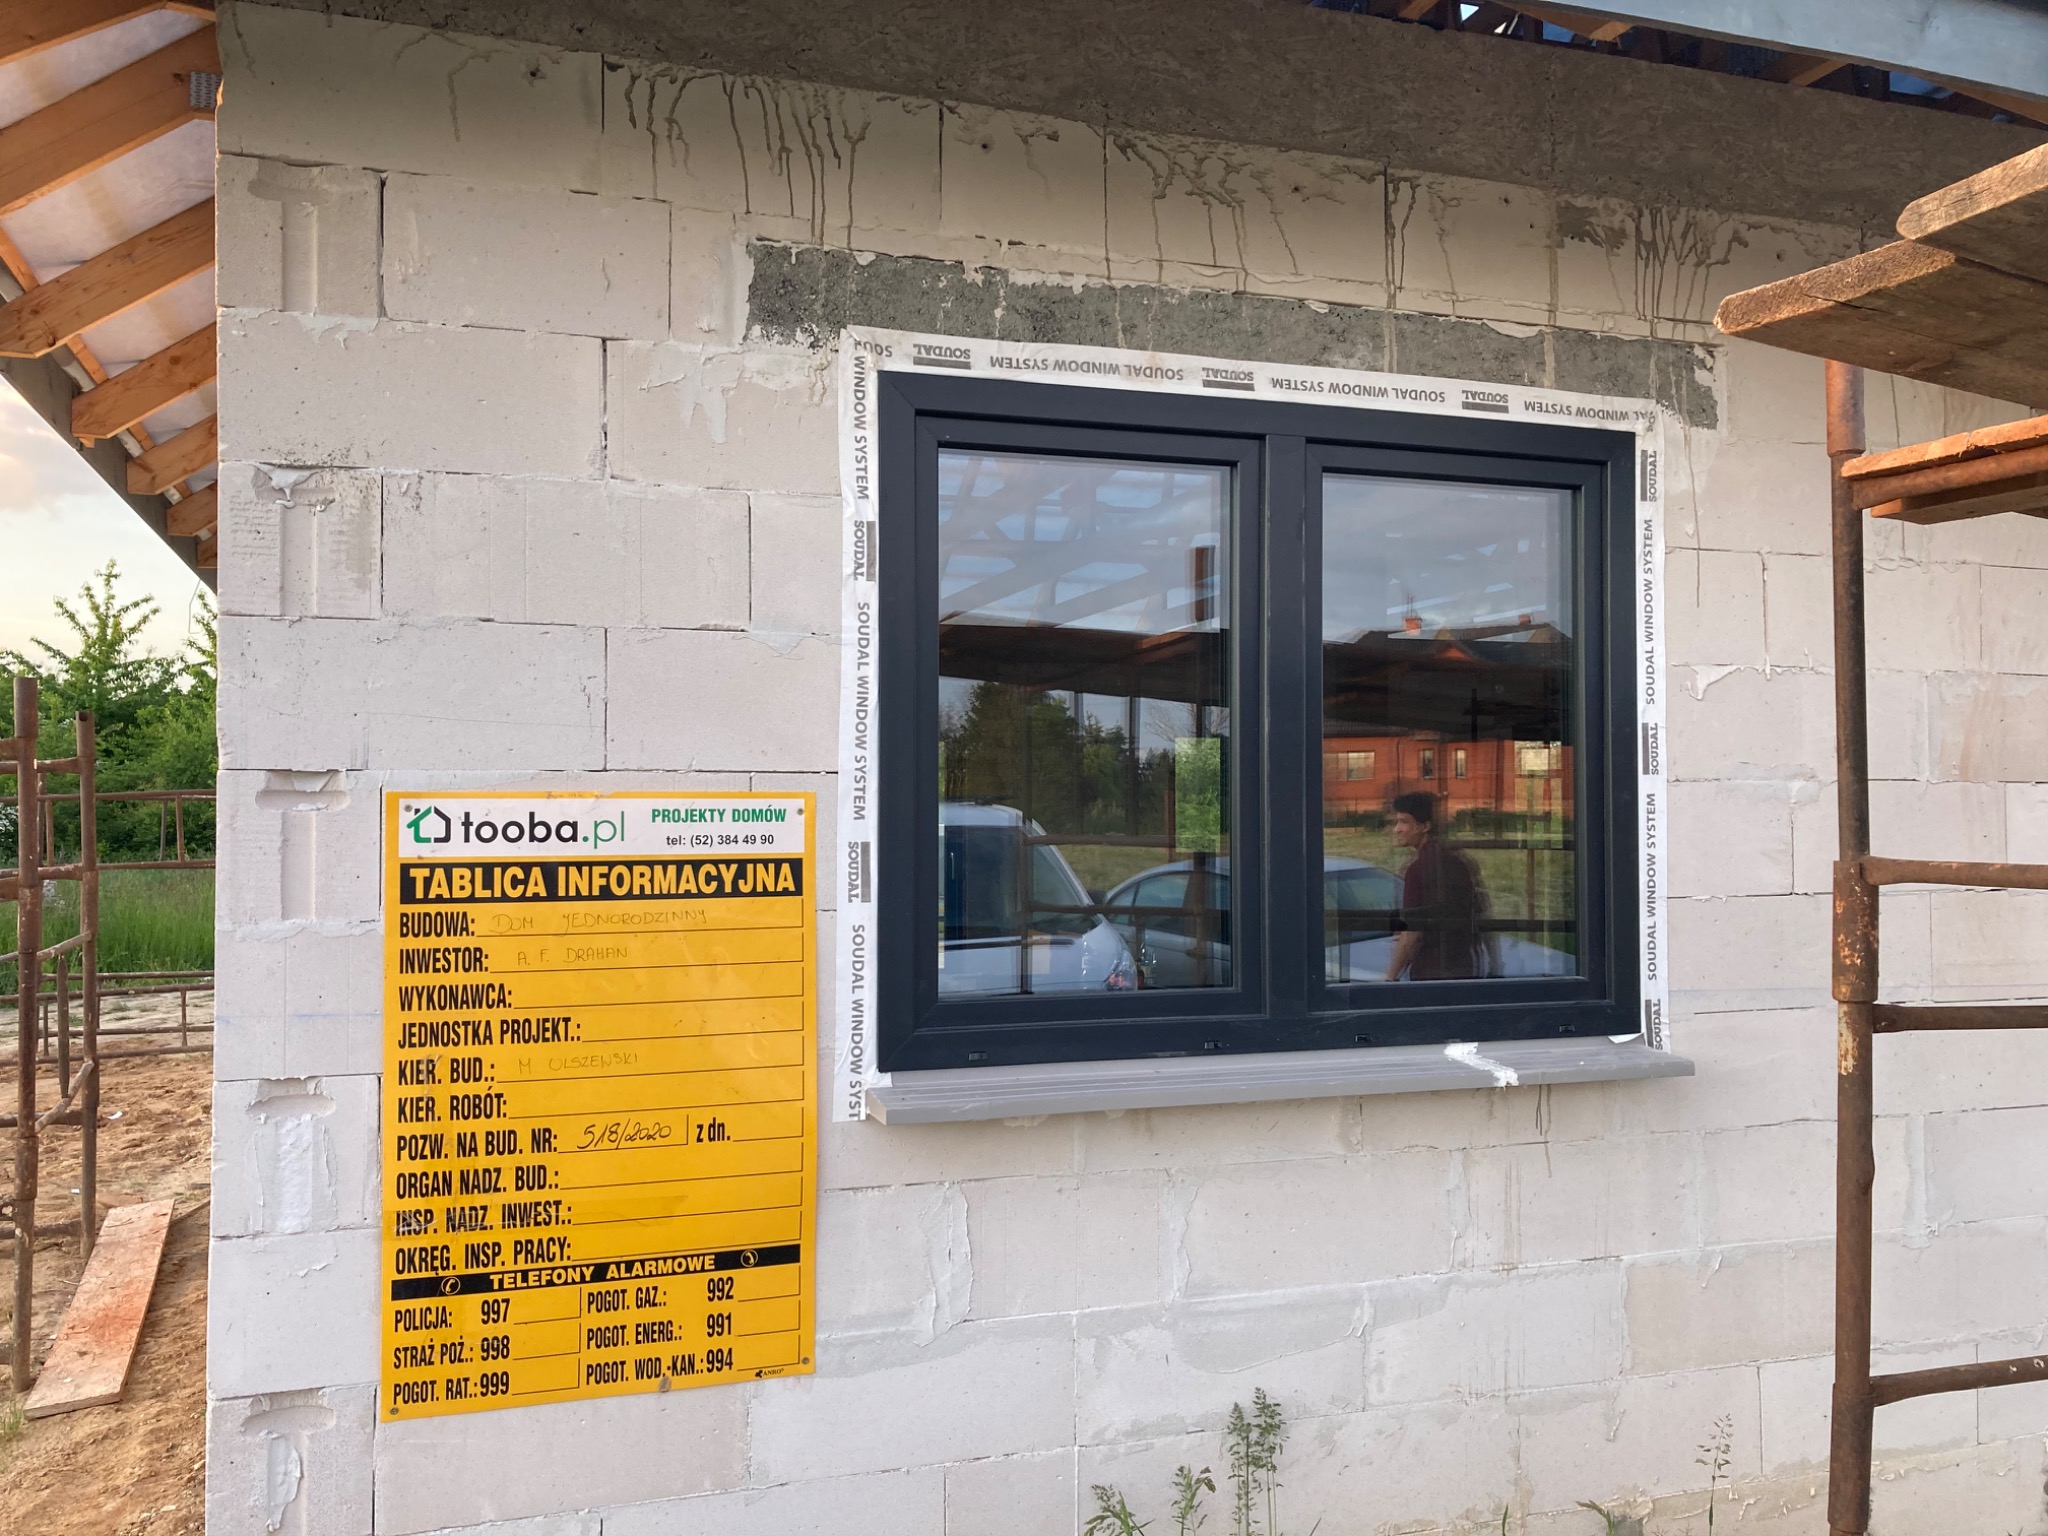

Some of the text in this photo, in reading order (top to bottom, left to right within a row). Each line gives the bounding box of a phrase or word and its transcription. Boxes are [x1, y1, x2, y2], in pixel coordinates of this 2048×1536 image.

[913, 343, 971, 360] SOUDAL
[990, 355, 1184, 381] SOUDAL WINDOW SYSTEM
[1202, 367, 1254, 382] SOUDAL
[854, 355, 867, 430] WINDOW
[1272, 377, 1445, 404] SOUDAL WINDOW SYSTEM
[1462, 389, 1509, 404] SOUDAL
[1524, 400, 1572, 415] SYSTEM
[1575, 405, 1629, 421] WINDOW
[854, 436, 869, 500] SYSTEM
[1648, 451, 1657, 502] SOUDAL
[854, 520, 865, 581] SOUDAL
[1643, 519, 1655, 705] SOUDAL WINDOW SYSTEM
[853, 602, 870, 821] SOUDAL WINDOW SYSTEM
[1650, 722, 1659, 775] SOUDAL
[461, 810, 625, 848] tooba.pl
[651, 804, 787, 824] PROJEKTY DOMÓW
[666, 833, 775, 848] tel: (52) 384 49 90
[409, 862, 796, 899] TABLICA INFORMACYJNA
[848, 841, 860, 903] SOUDAL
[1646, 793, 1657, 981] SOUDAL WINDOW SYSTEM
[399, 912, 476, 938] BUDOWA:
[489, 909, 707, 938] DOM JEDNORODZINNY
[399, 949, 490, 974] INWESTOR:
[517, 951, 531, 966] A.
[540, 949, 550, 963] F.
[852, 924, 865, 994] SOUDAL
[398, 983, 513, 1012] WYKONAWCA:
[397, 1016, 581, 1049] JEDNOSTKA PROJEKT.:
[850, 998, 864, 1075] WINDOW
[1653, 998, 1663, 1051] SOUDAL
[397, 1056, 496, 1086] KIER. BUD.:
[397, 1087, 508, 1124] KIER. ROBÓT:
[396, 1126, 558, 1162] POZW. NA BUD. NR:
[696, 1117, 731, 1143] z dn.
[395, 1164, 559, 1200] ORGAN NADZ. BUD.:
[395, 1200, 572, 1237] INSP. NADZ. INWEST.:
[394, 1237, 571, 1277] OKRĘG. INSP. PRACY:
[489, 1254, 716, 1290] TELEFONY ALARMOWE
[586, 1285, 667, 1314] POGOT. GAZ.:
[706, 1276, 735, 1302] 992
[393, 1307, 453, 1333] POLICJA:
[480, 1298, 511, 1325] 997
[705, 1311, 733, 1337] 991
[480, 1335, 510, 1361] 998
[586, 1319, 682, 1350] POGOT. ENERG.:
[393, 1336, 474, 1370] STRAŻ POŻ.:
[705, 1346, 734, 1372] 994
[585, 1352, 704, 1385] POGOT. WOD.-KAN.:
[393, 1376, 478, 1406] POGOT. RAT.:
[479, 1370, 510, 1398] 999
